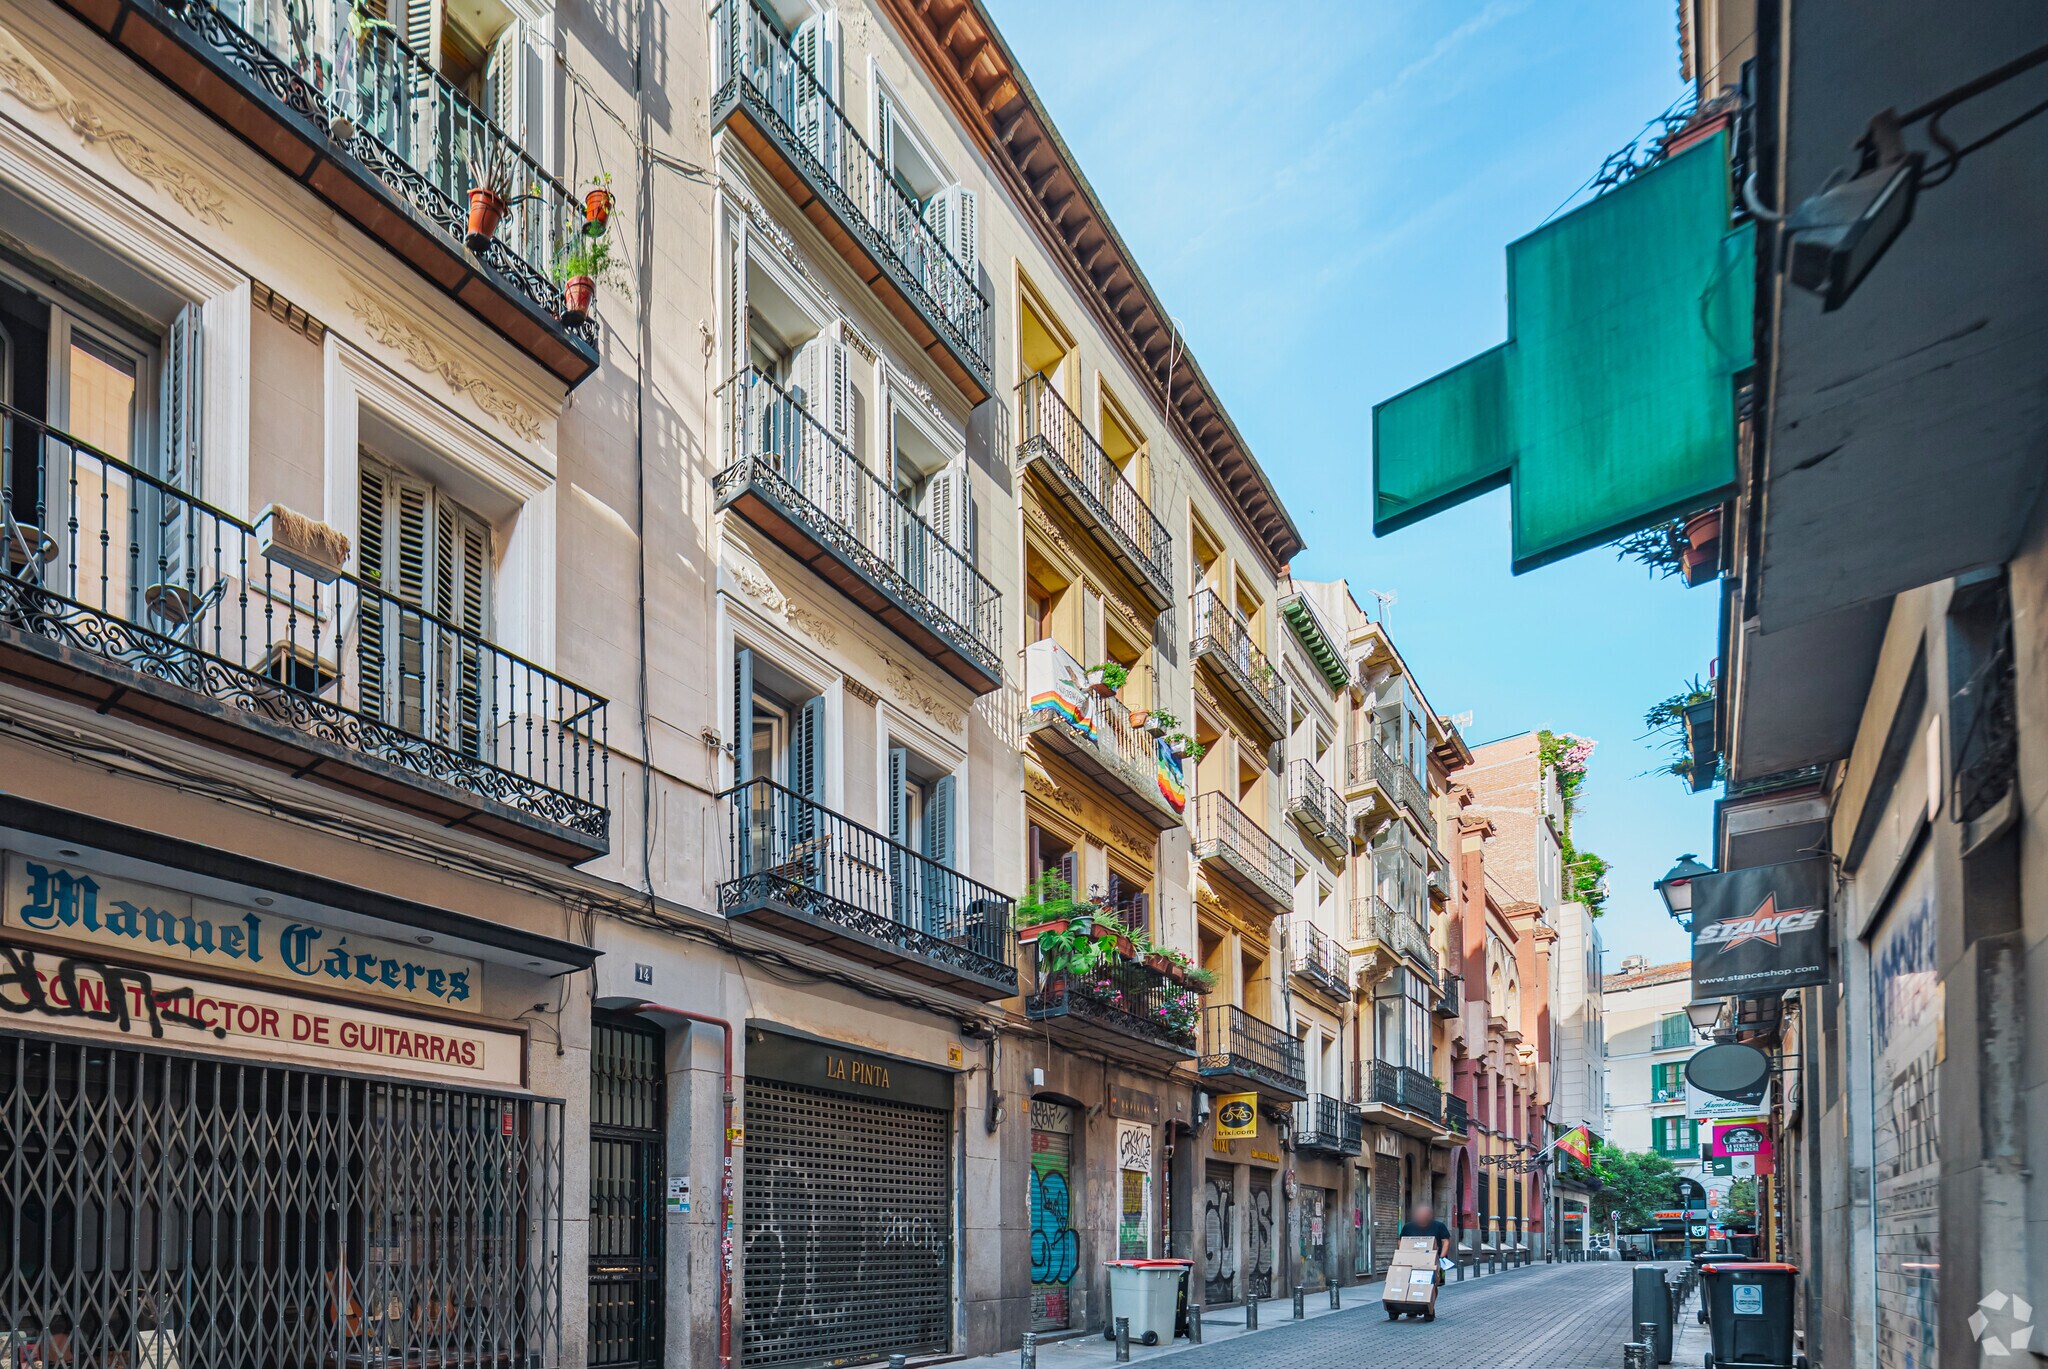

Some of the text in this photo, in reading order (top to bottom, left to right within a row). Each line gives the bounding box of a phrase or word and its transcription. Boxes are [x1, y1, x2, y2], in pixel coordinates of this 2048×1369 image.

[20, 861, 264, 963] Manuel
[280, 923, 470, 1004] Cáceres
[1697, 909, 1825, 940] STANCE
[638, 966, 650, 982] 14
[1698, 965, 1820, 985] www.stanceshop.com
[20, 970, 279, 1038] CONTUCTOR
[292, 1013, 330, 1045] DE
[339, 1021, 476, 1066] GUITARRAS
[827, 1055, 890, 1089] LA PINTA
